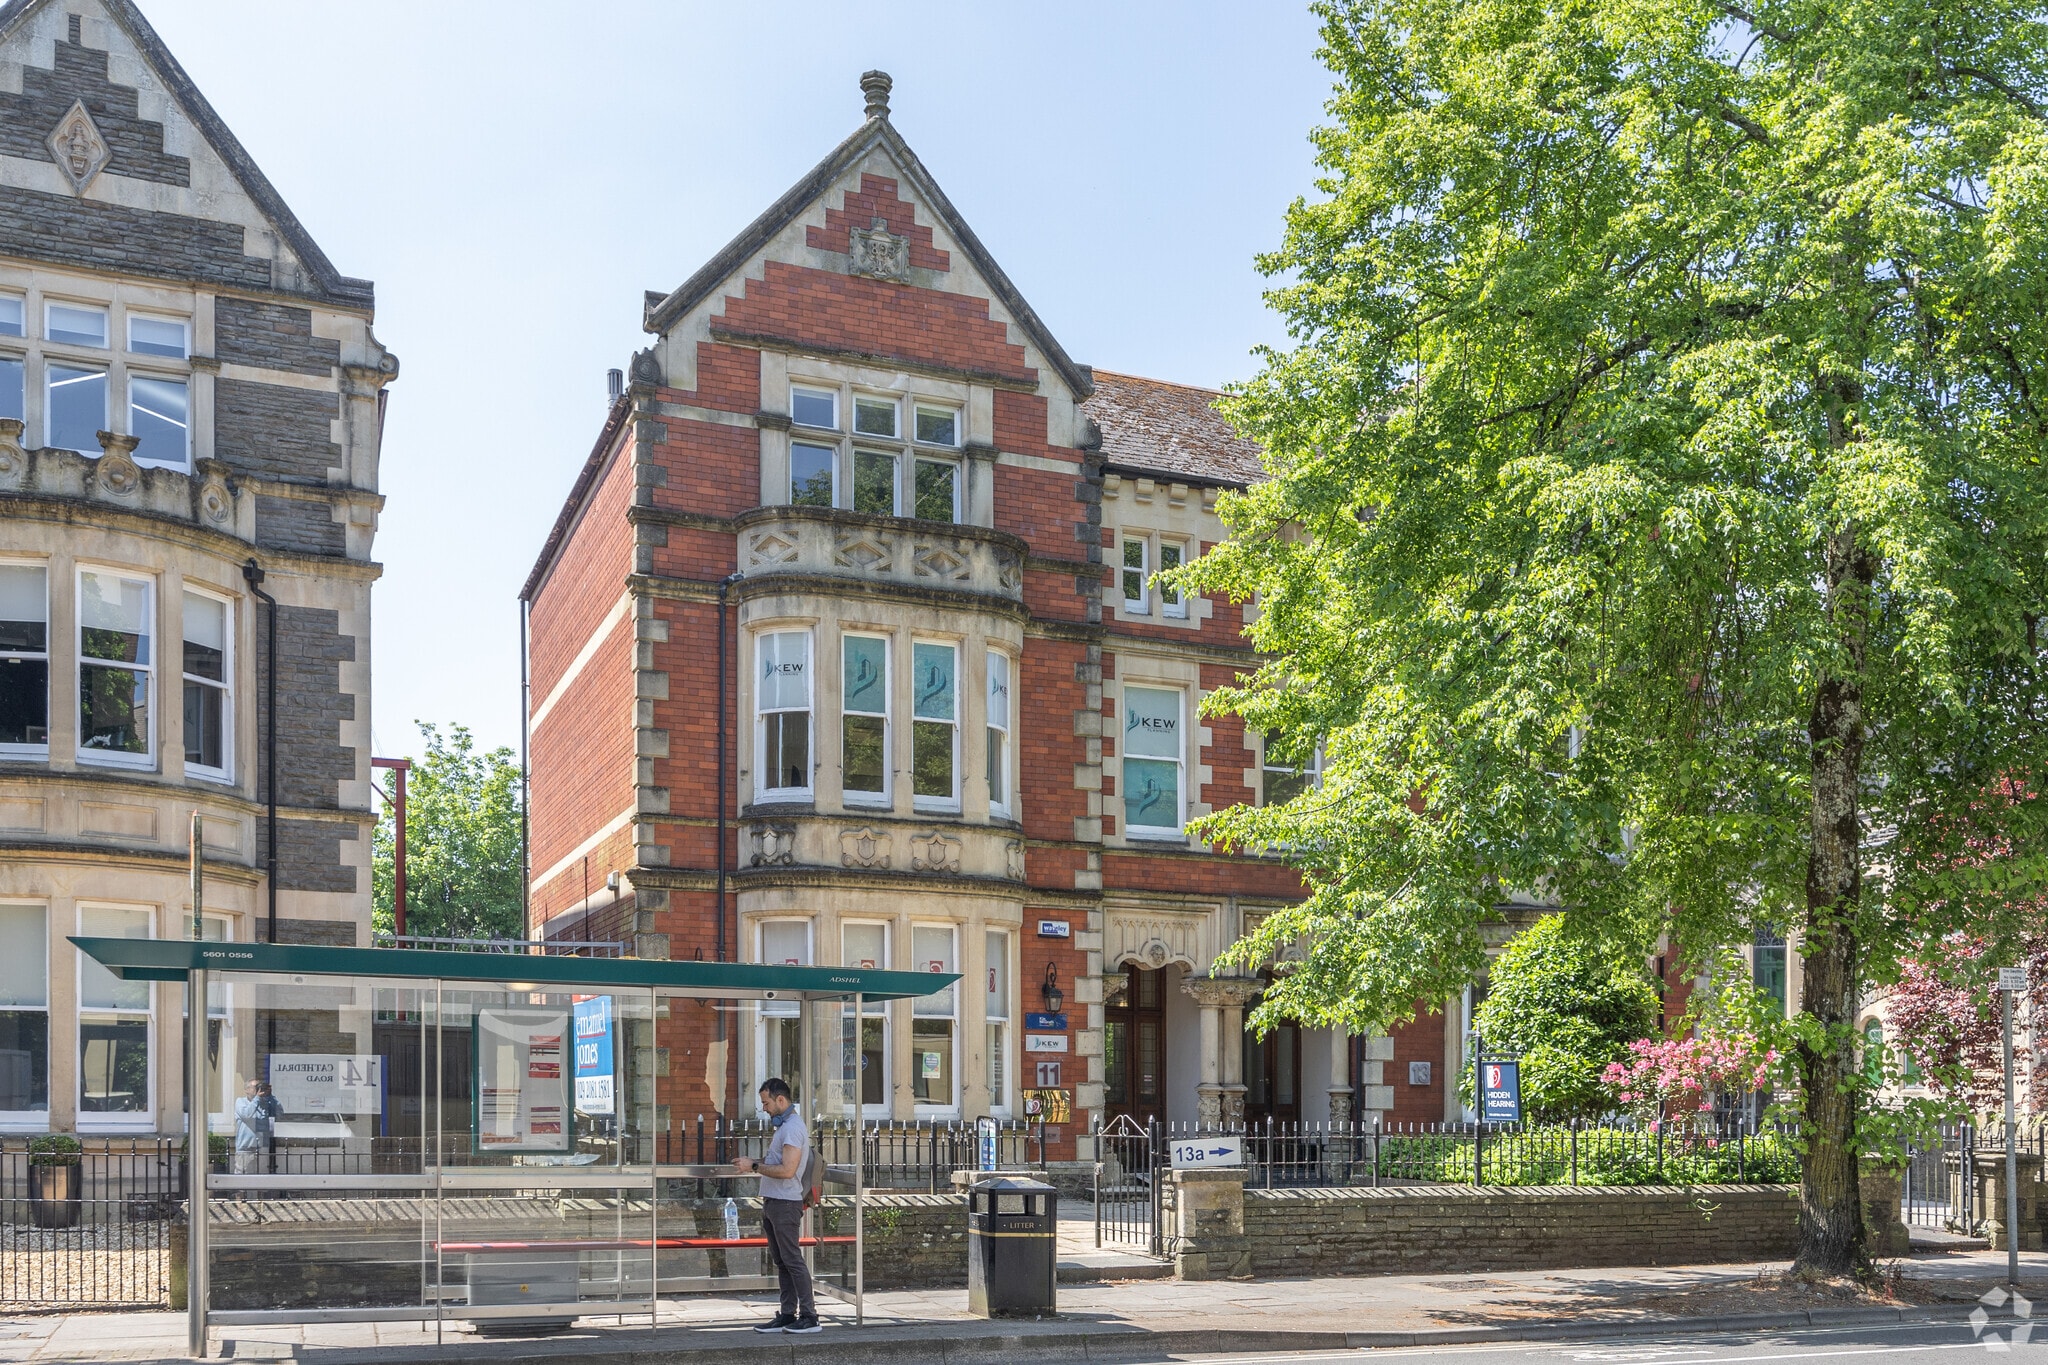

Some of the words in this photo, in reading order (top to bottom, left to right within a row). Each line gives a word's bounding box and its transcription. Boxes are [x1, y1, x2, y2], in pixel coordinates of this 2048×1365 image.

[774, 663, 804, 672] KEW
[1142, 717, 1176, 729] KEW
[829, 976, 862, 984] ADSHEL
[1041, 1040, 1059, 1048] KEW
[576, 1036, 599, 1076] jones
[1039, 1064, 1059, 1086] 11
[1412, 1063, 1430, 1084] 13
[1487, 1091, 1511, 1099] HIDDEN
[1487, 1100, 1515, 1108] HEARING
[1175, 1146, 1205, 1162] 13a
